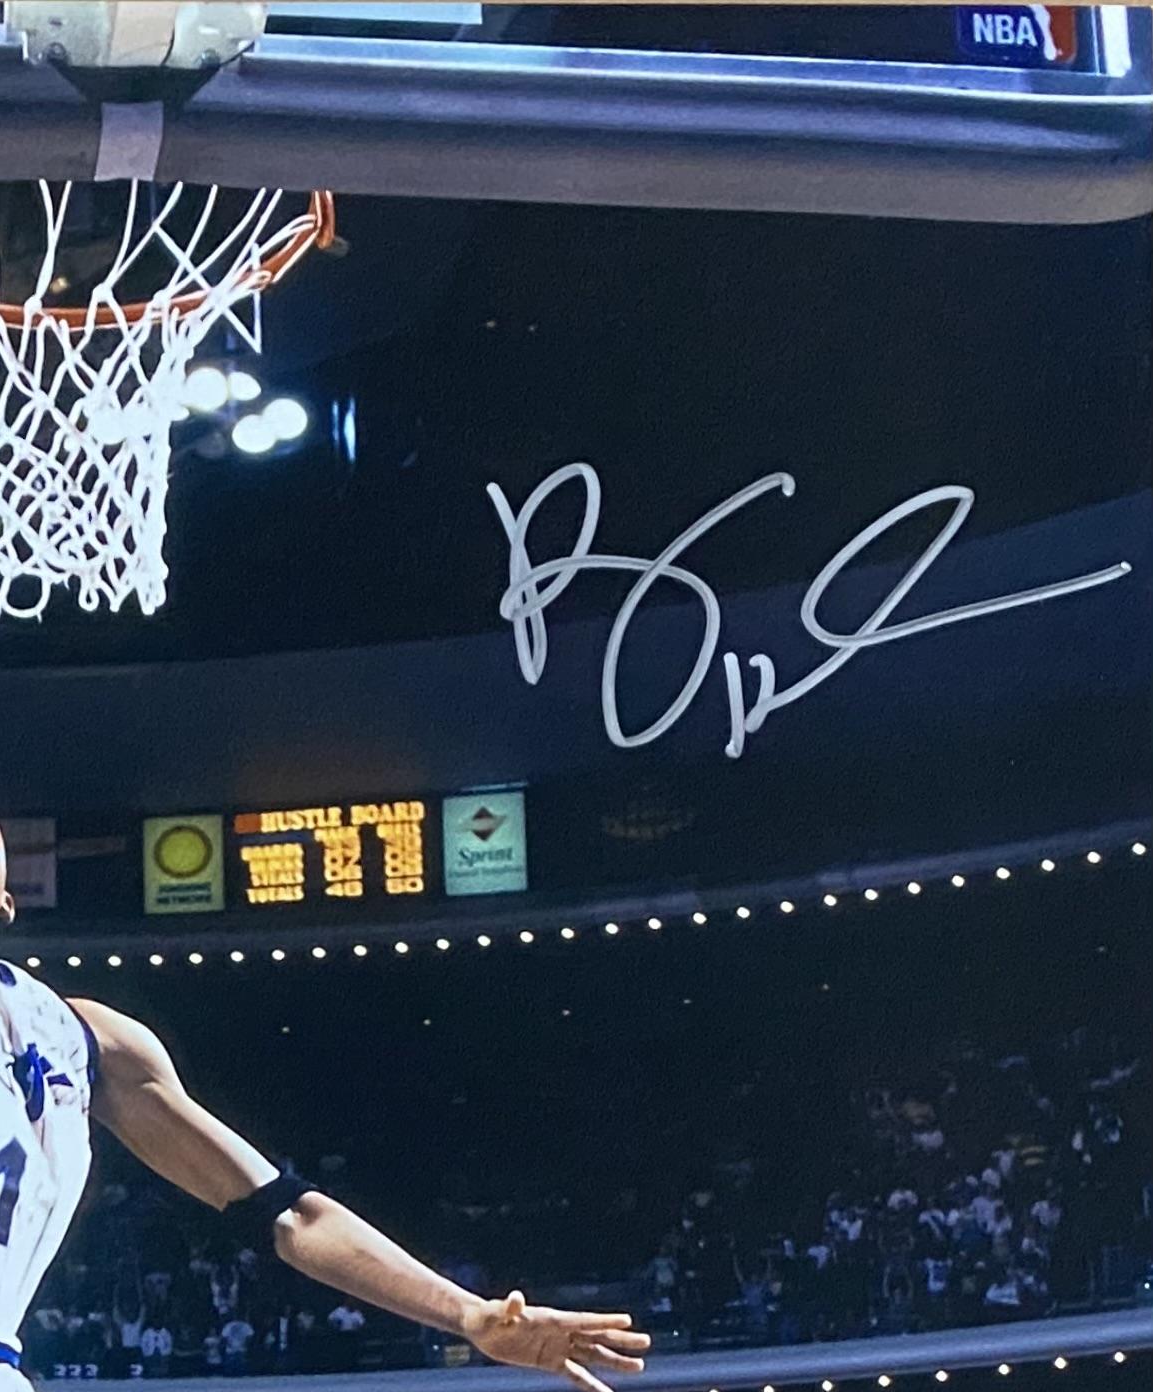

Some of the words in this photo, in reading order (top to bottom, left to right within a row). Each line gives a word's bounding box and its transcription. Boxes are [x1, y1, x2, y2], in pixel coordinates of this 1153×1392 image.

[973, 13, 1038, 47] NBA
[261, 806, 342, 833] HUSTLE
[351, 801, 425, 826] BOARD
[458, 847, 513, 868] Sprint
